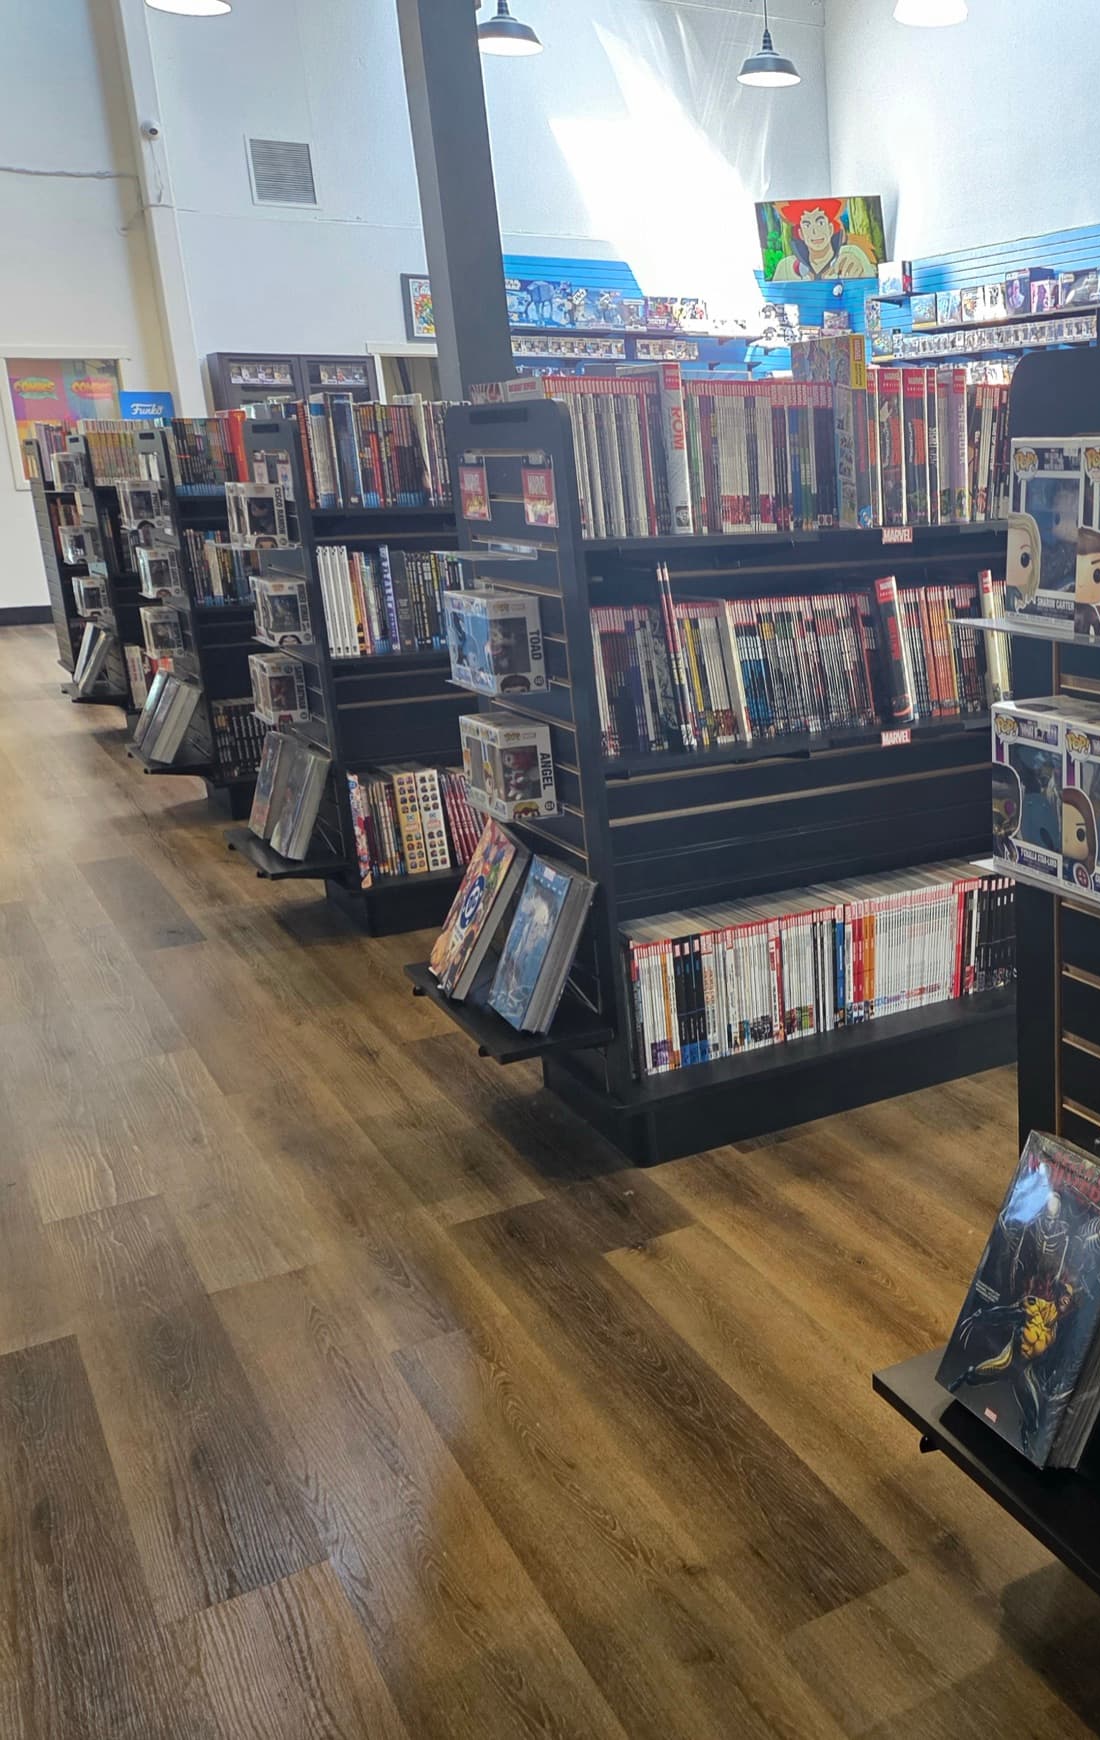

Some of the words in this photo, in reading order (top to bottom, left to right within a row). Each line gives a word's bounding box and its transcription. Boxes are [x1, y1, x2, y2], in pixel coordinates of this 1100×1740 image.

[130, 402, 164, 416] Funko
[671, 405, 686, 450] ROM
[1013, 450, 1038, 470] POP!
[883, 528, 912, 543] MARVEL
[529, 629, 543, 661] TOAD
[995, 713, 1018, 737] POP!
[882, 729, 911, 746] MARVEL
[1065, 730, 1091, 754] POP!
[539, 751, 554, 791] ANGEL
